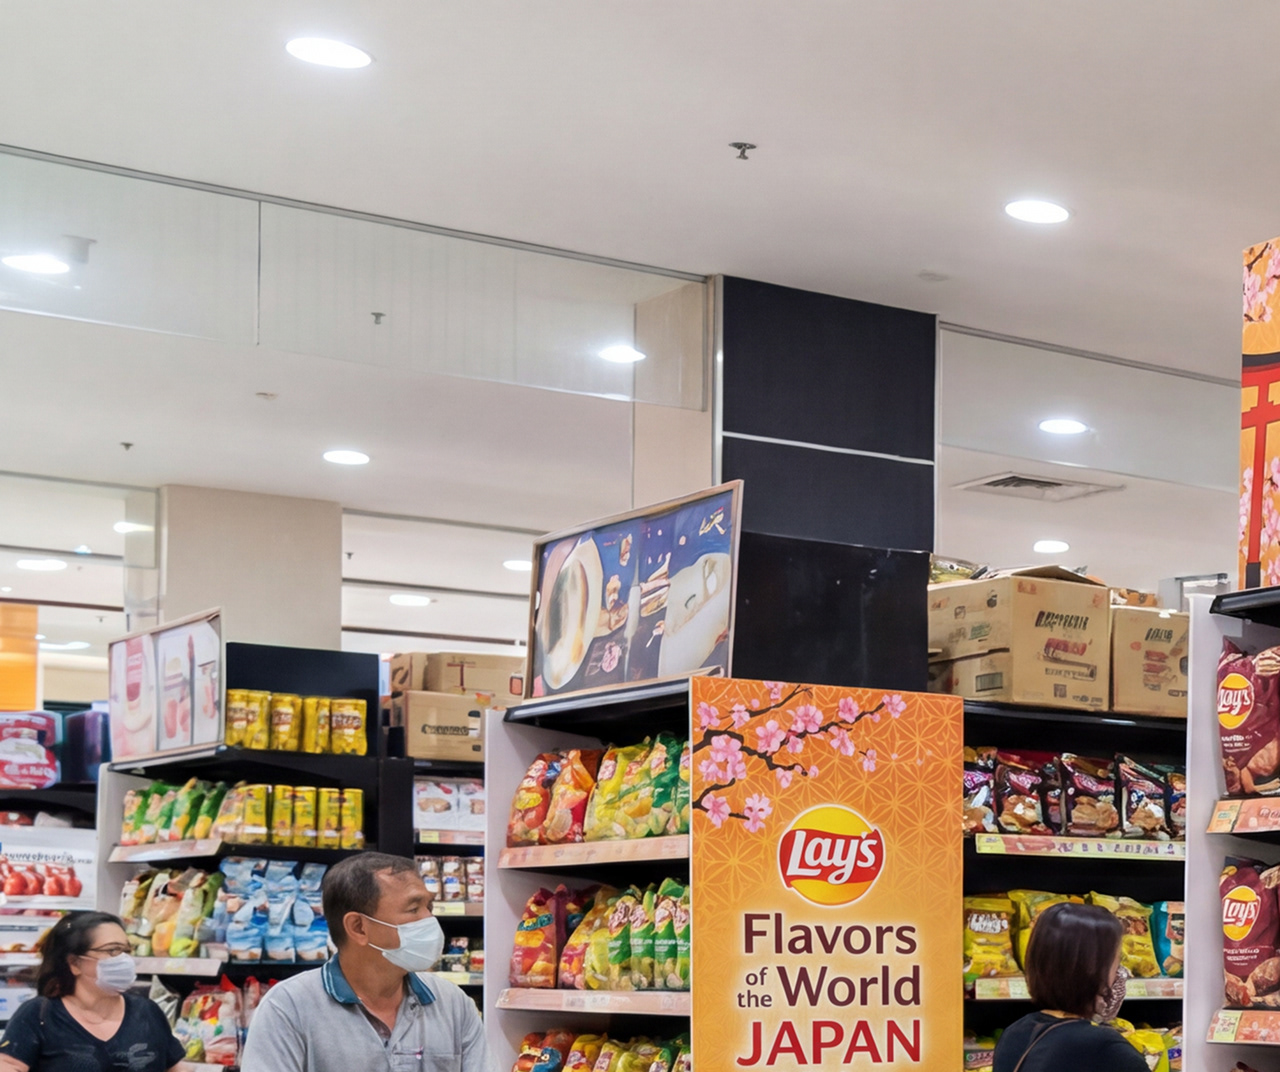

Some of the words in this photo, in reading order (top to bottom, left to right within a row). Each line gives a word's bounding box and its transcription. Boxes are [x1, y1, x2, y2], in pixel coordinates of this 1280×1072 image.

[785, 829, 877, 883] Lay's
[744, 913, 917, 955] Flavors
[737, 990, 772, 1008] the
[776, 965, 921, 1007] World
[745, 967, 767, 986] of
[737, 1019, 920, 1066] JAPAN
